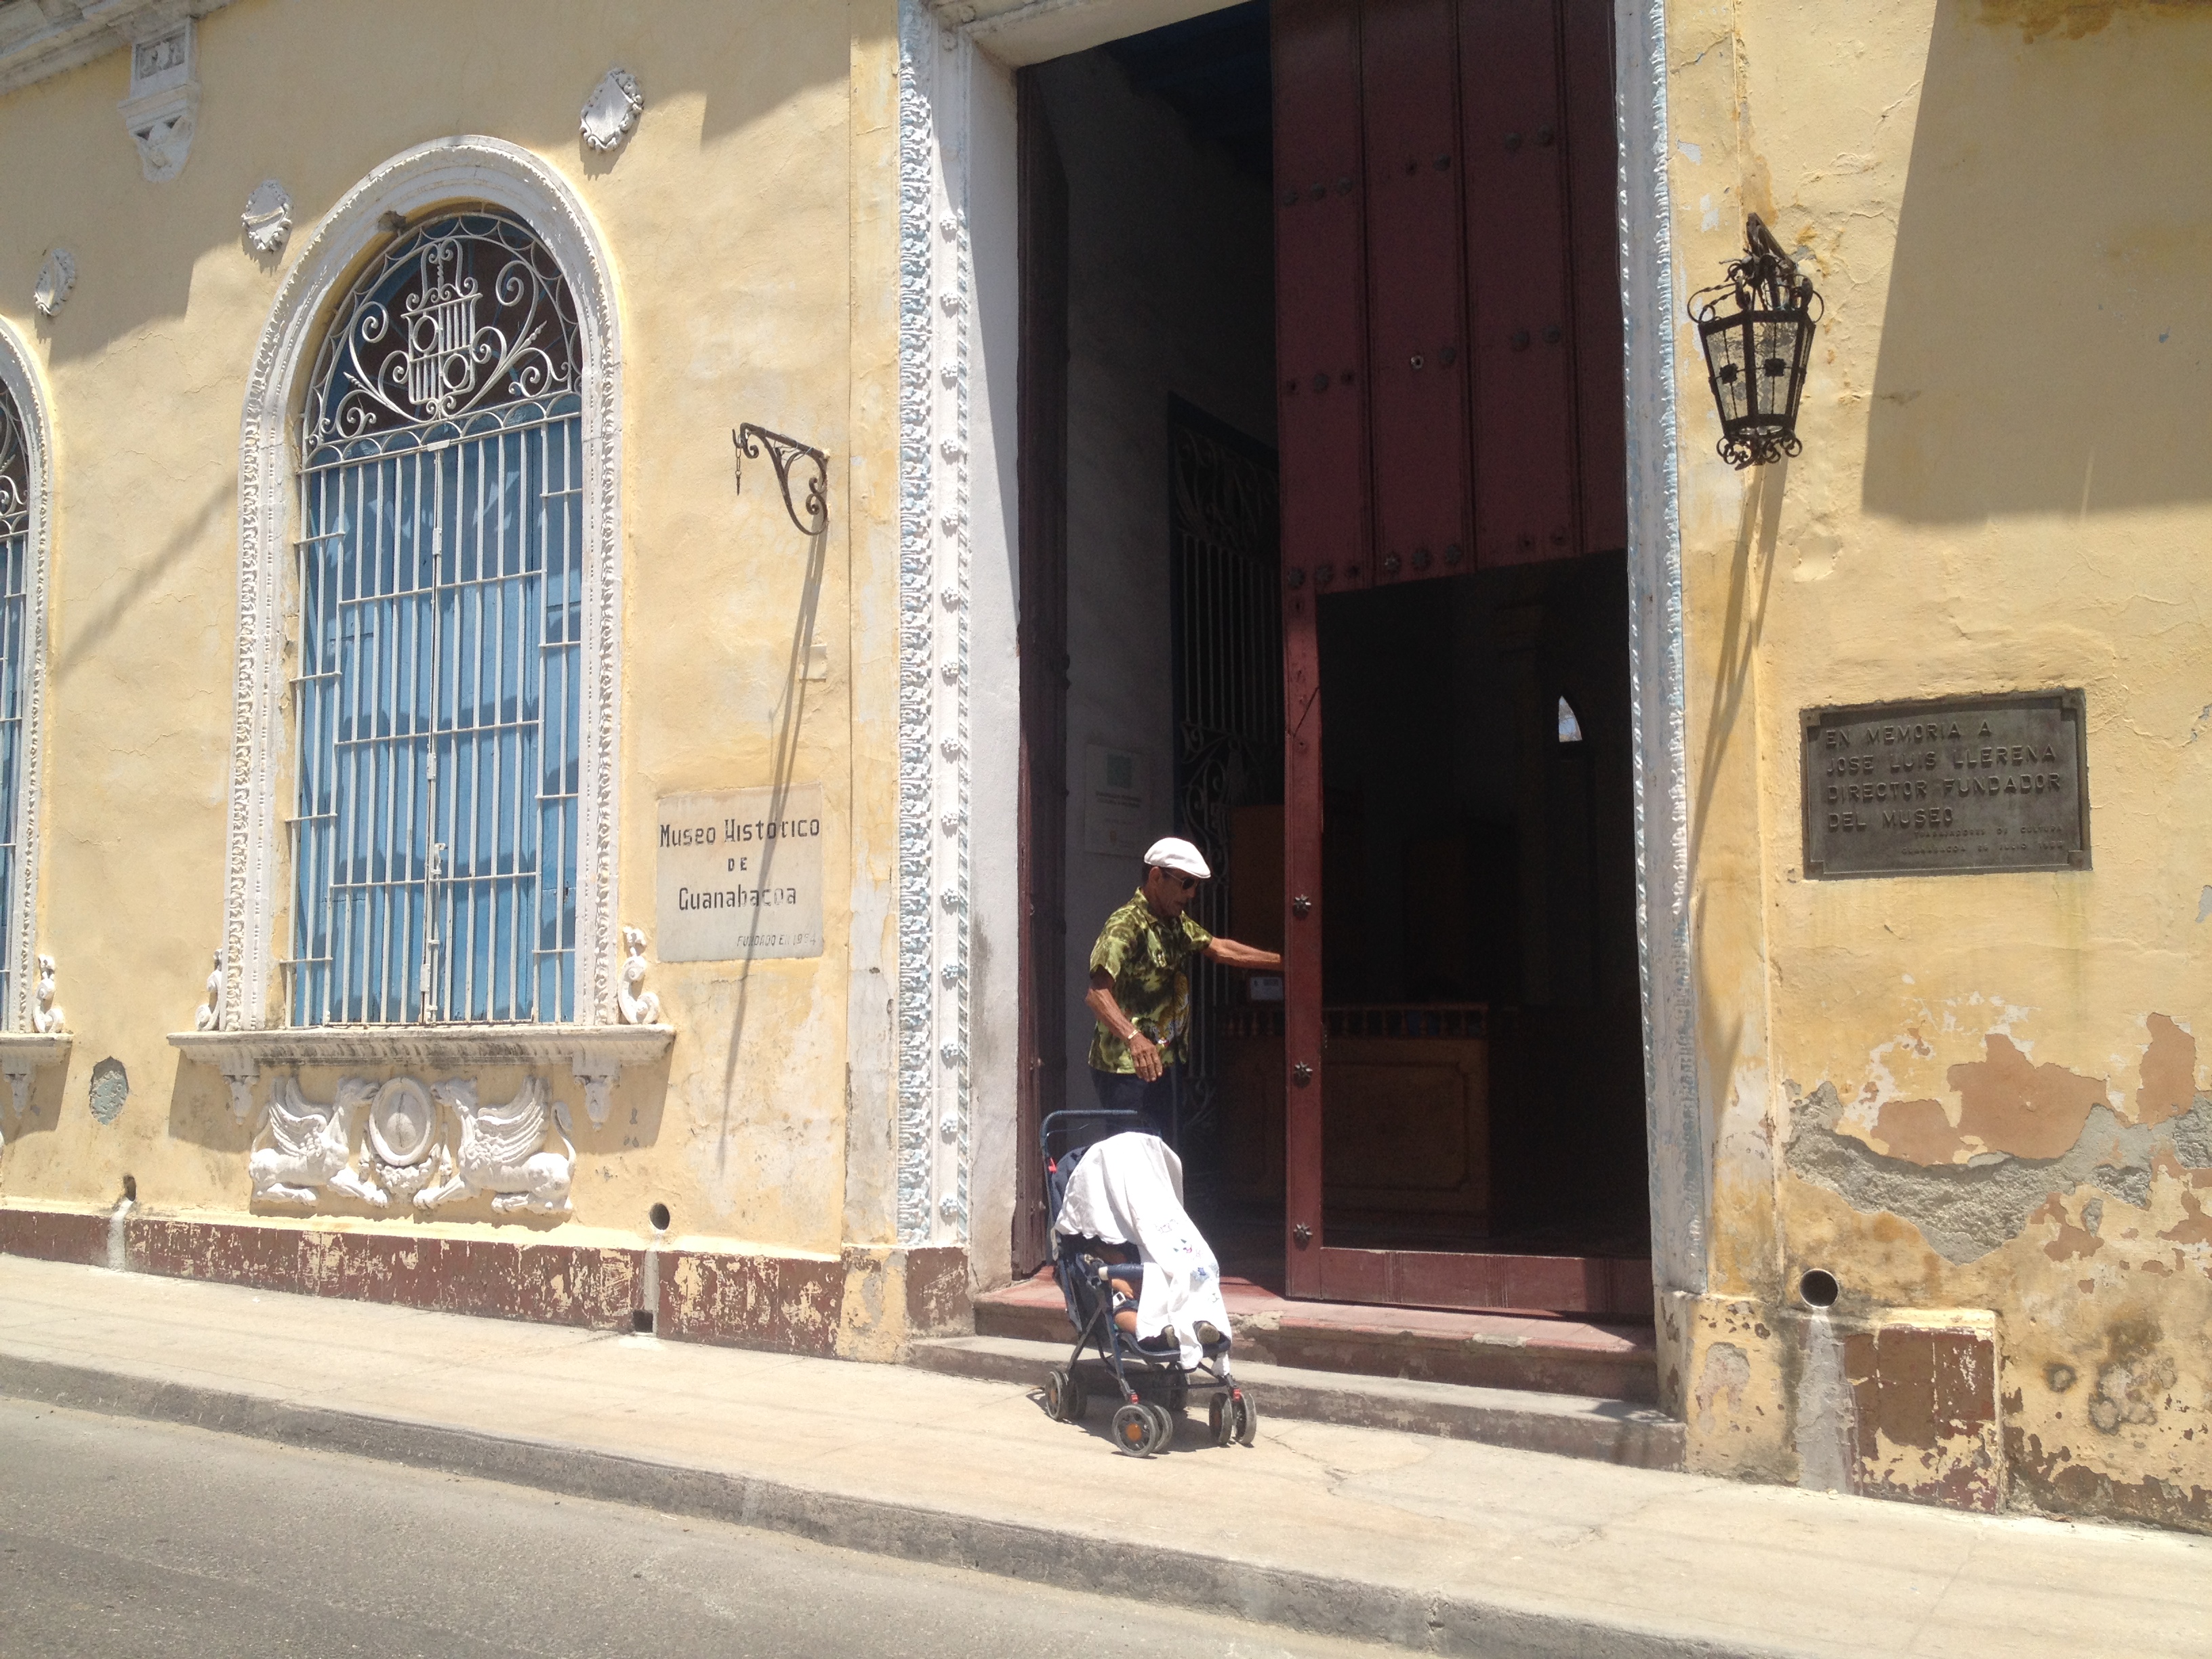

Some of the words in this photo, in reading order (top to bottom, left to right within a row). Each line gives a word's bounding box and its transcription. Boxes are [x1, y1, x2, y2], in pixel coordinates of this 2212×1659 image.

[1826, 729, 1851, 749] EN
[1866, 722, 1961, 745] MEMORIA
[1978, 720, 1991, 737] A
[1827, 755, 1874, 776] JOSE
[1890, 752, 1936, 773] LUIS
[1953, 744, 2055, 769] LLERENA
[1827, 780, 1927, 804] DIRECTOR
[1944, 773, 2060, 798] FUNDADOR
[1828, 812, 1867, 832] DEL
[1883, 806, 1953, 828] MUSEO
[659, 824, 716, 848] Museo
[728, 857, 747, 872] DE
[679, 884, 796, 910] Guanabacoa
